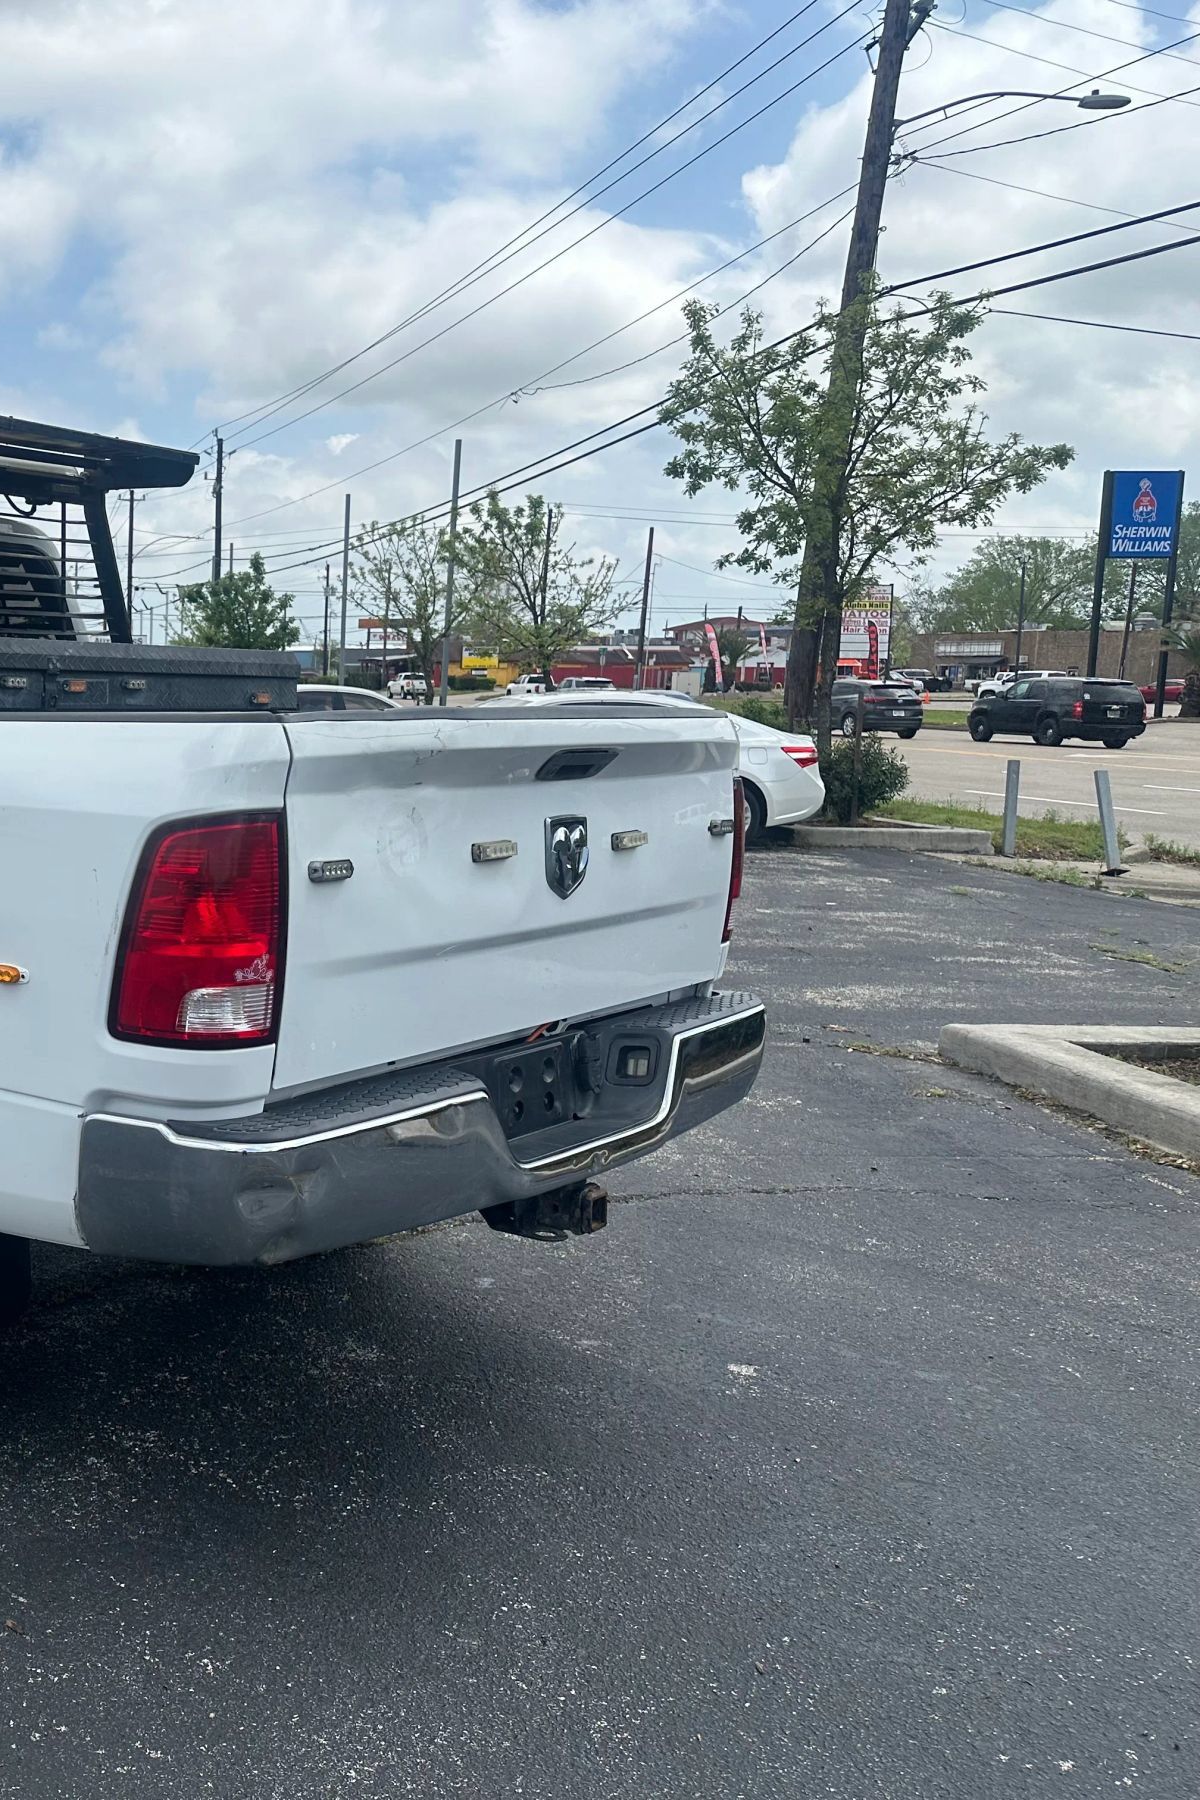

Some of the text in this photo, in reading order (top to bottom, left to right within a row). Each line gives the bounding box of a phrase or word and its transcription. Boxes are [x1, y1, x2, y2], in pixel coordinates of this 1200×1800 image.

[1113, 524, 1171, 538] SHERWIN
[1111, 539, 1171, 552] WILLIAMS
[844, 601, 867, 609] Alpha
[843, 610, 889, 618] TATTOO
